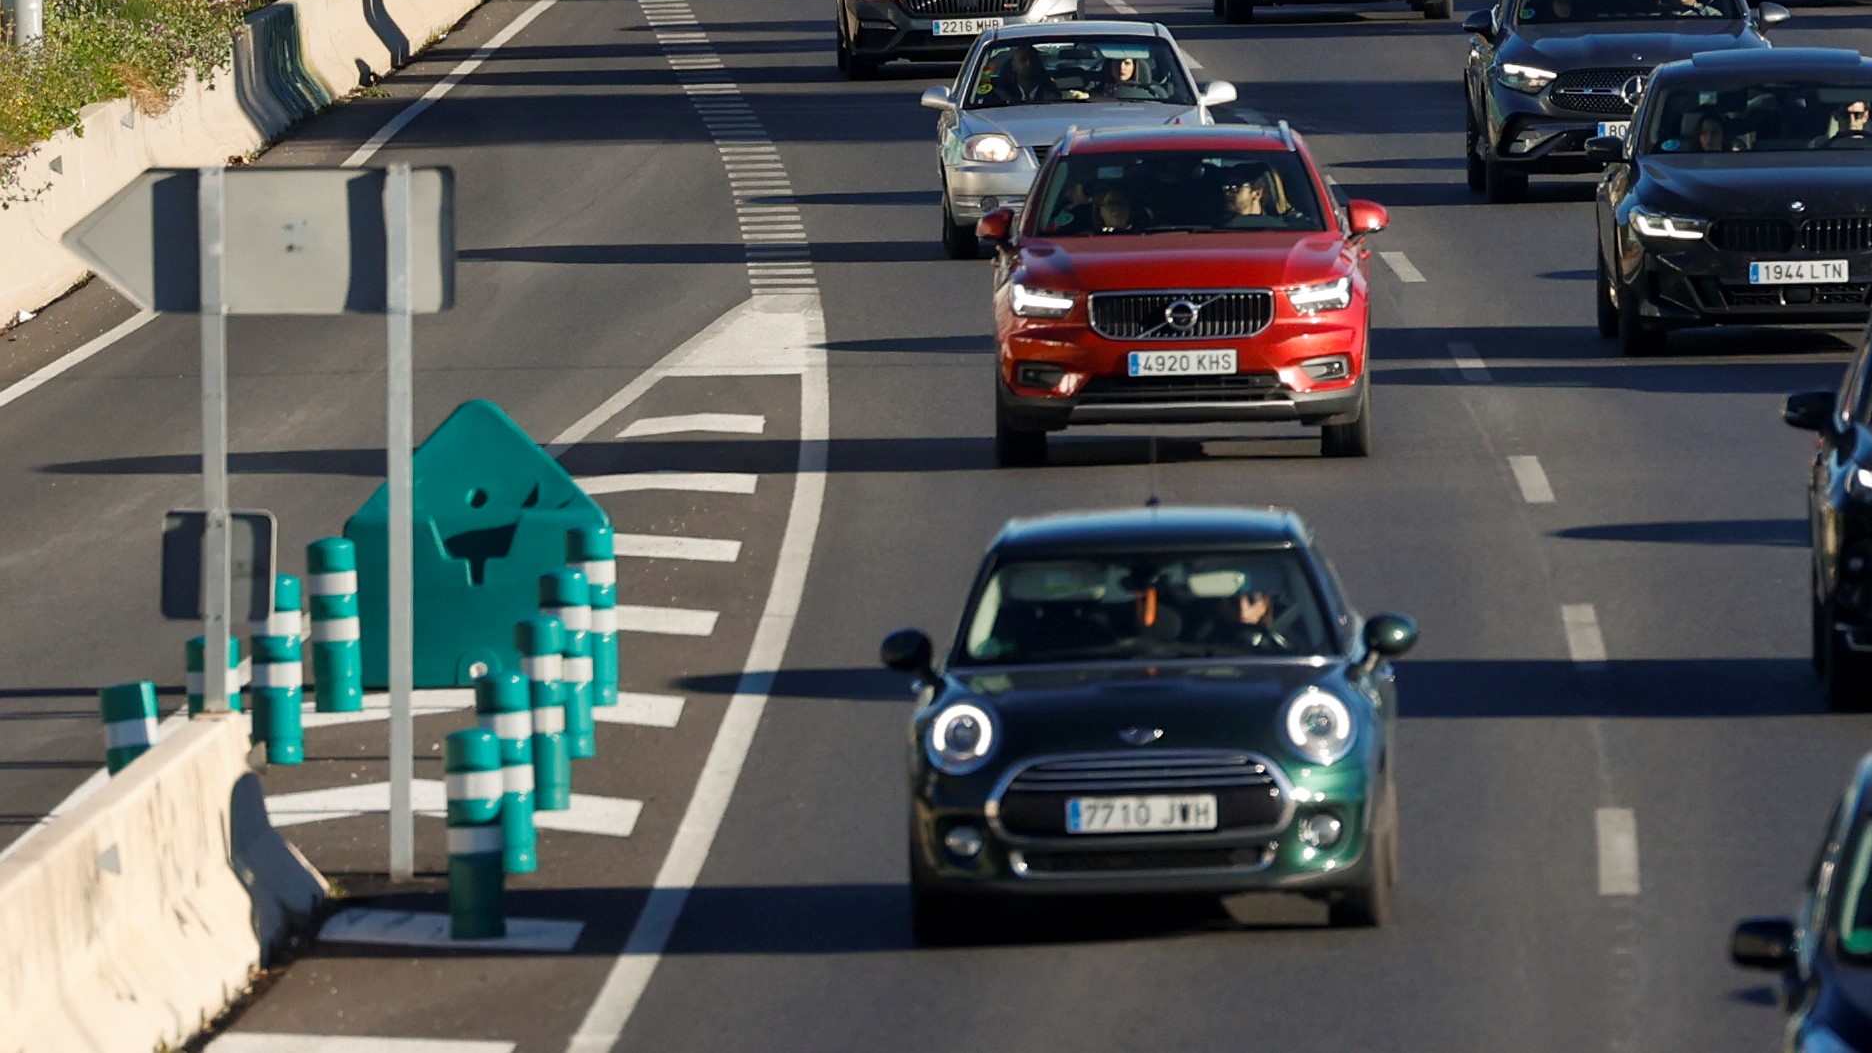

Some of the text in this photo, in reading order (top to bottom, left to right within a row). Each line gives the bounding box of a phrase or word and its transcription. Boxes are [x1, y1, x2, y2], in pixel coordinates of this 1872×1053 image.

[942, 20, 973, 33] 2216
[1764, 263, 1843, 280] 1944 LTN
[1143, 354, 1232, 372] 4920 KHS
[1086, 802, 1209, 827] 7710 JWH
